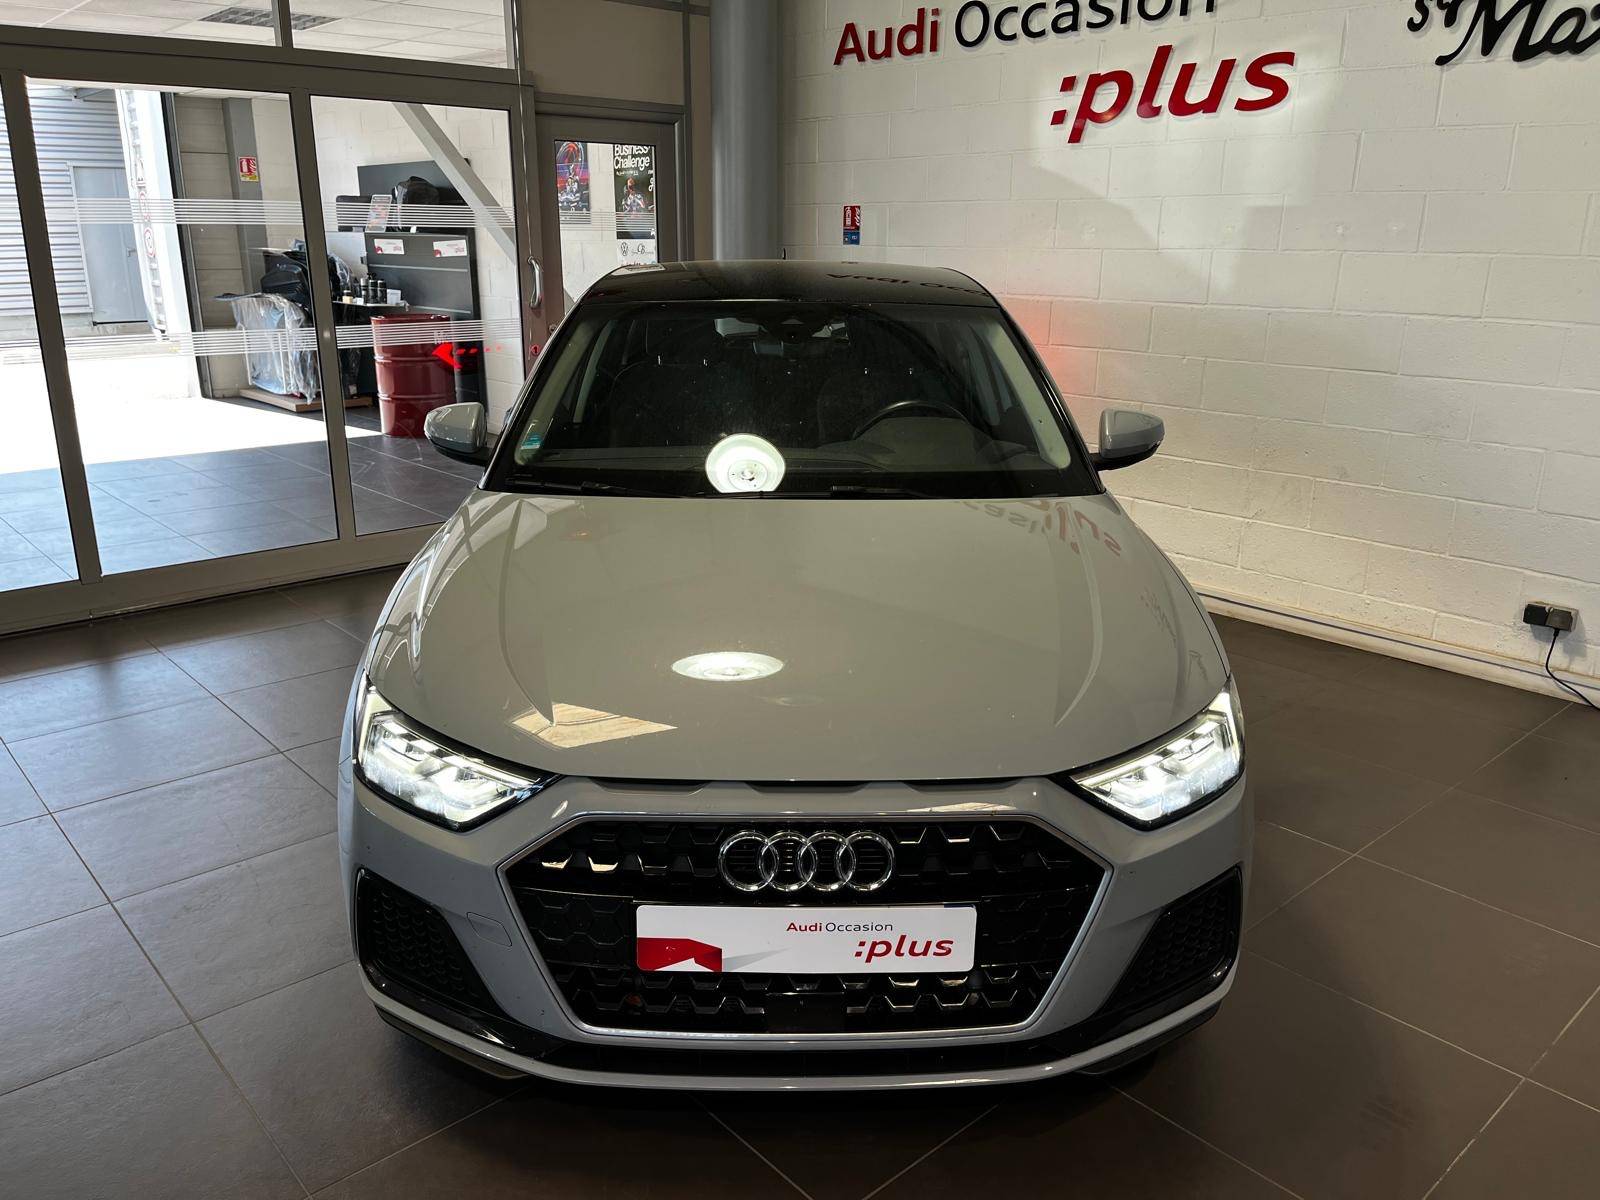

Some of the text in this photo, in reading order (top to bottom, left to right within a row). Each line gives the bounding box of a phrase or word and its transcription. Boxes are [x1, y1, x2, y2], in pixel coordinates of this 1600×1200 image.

[833, 7, 940, 66] Audi
[1435, 0, 1600, 66] Ma
[1050, 44, 1296, 143] :plus
[614, 144, 650, 156] Business
[614, 155, 650, 171] Challenge
[786, 921, 893, 932] Audi Occasion
[854, 934, 955, 963] :plus
